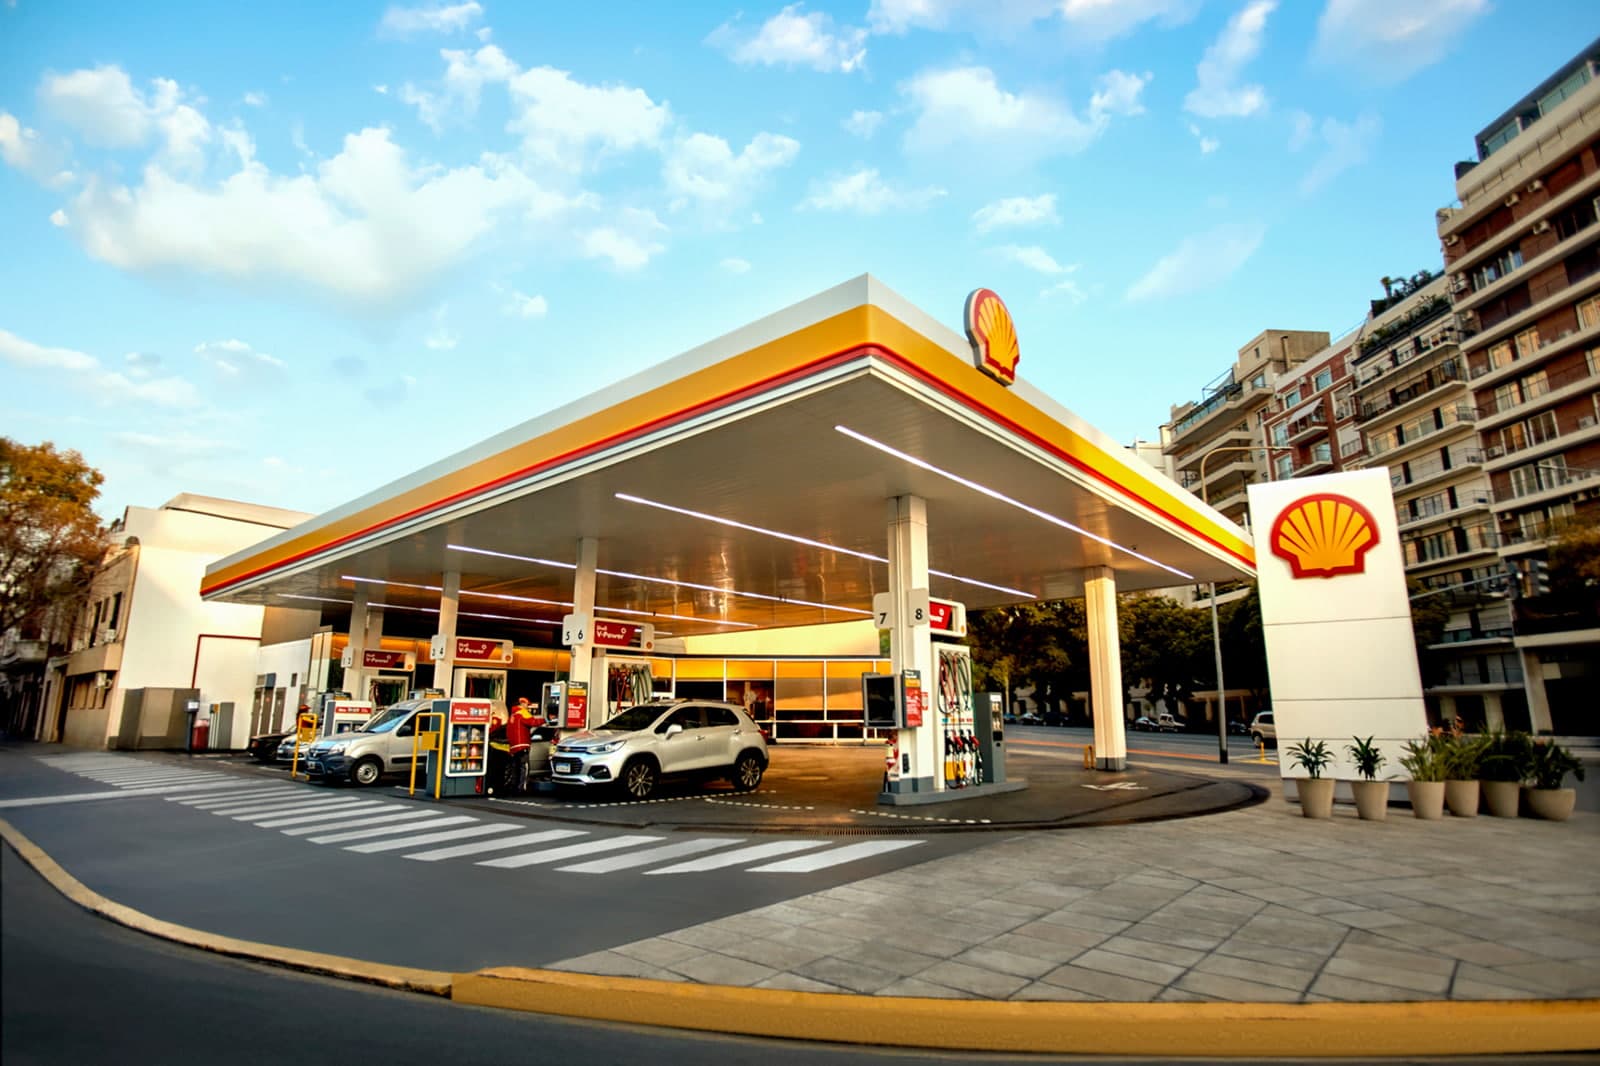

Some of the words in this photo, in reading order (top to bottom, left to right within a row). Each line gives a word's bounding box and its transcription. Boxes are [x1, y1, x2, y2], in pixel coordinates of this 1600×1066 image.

[879, 613, 888, 625] 7
[915, 608, 923, 620] 8
[566, 631, 571, 641] 5
[578, 629, 584, 640] 6
[596, 630, 625, 640] V-Power
